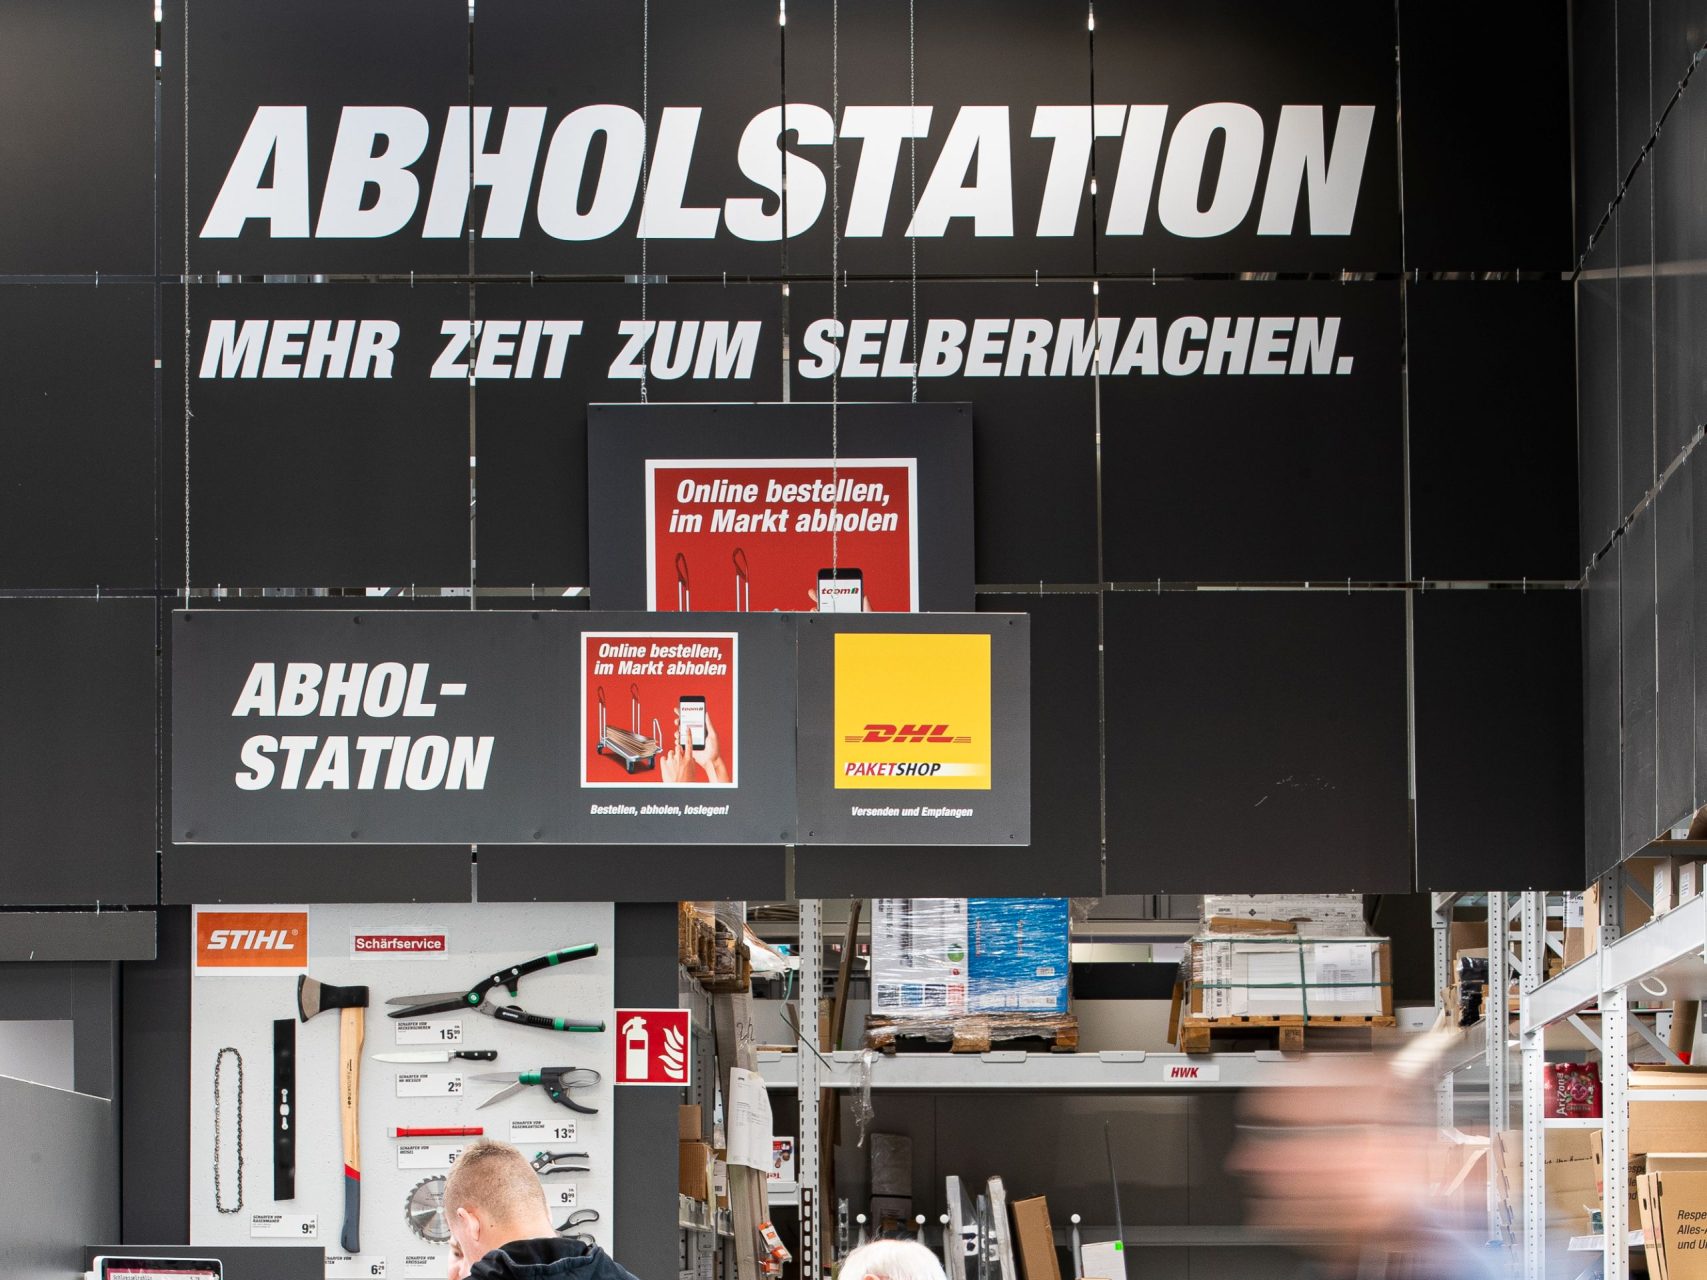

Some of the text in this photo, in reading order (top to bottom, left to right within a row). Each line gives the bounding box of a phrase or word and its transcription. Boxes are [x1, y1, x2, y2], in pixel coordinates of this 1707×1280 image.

[199, 102, 1375, 241] ABHOLSTATION
[199, 316, 1354, 380] MEHR ZEIT ZUM SELBERMACHEN.
[677, 478, 890, 506] Online bestellen,
[669, 508, 898, 533] im Markt abholen
[599, 643, 722, 660] Online bestellen,
[594, 661, 727, 675] im Markt abholen
[232, 662, 467, 718] ABHOL-
[862, 724, 954, 743] DHL
[235, 735, 495, 791] STATION
[845, 762, 941, 776] PAKETSHOP
[590, 804, 730, 817] Bestellen, abholen, loslegen!
[851, 806, 973, 818] Versenden und Empfangen
[356, 937, 442, 950] Schärfservice
[1171, 1066, 1199, 1078] HWK
[1556, 1072, 1568, 1116] AriZona
[1677, 1210, 1707, 1221] Respe
[1677, 1239, 1695, 1249] und
